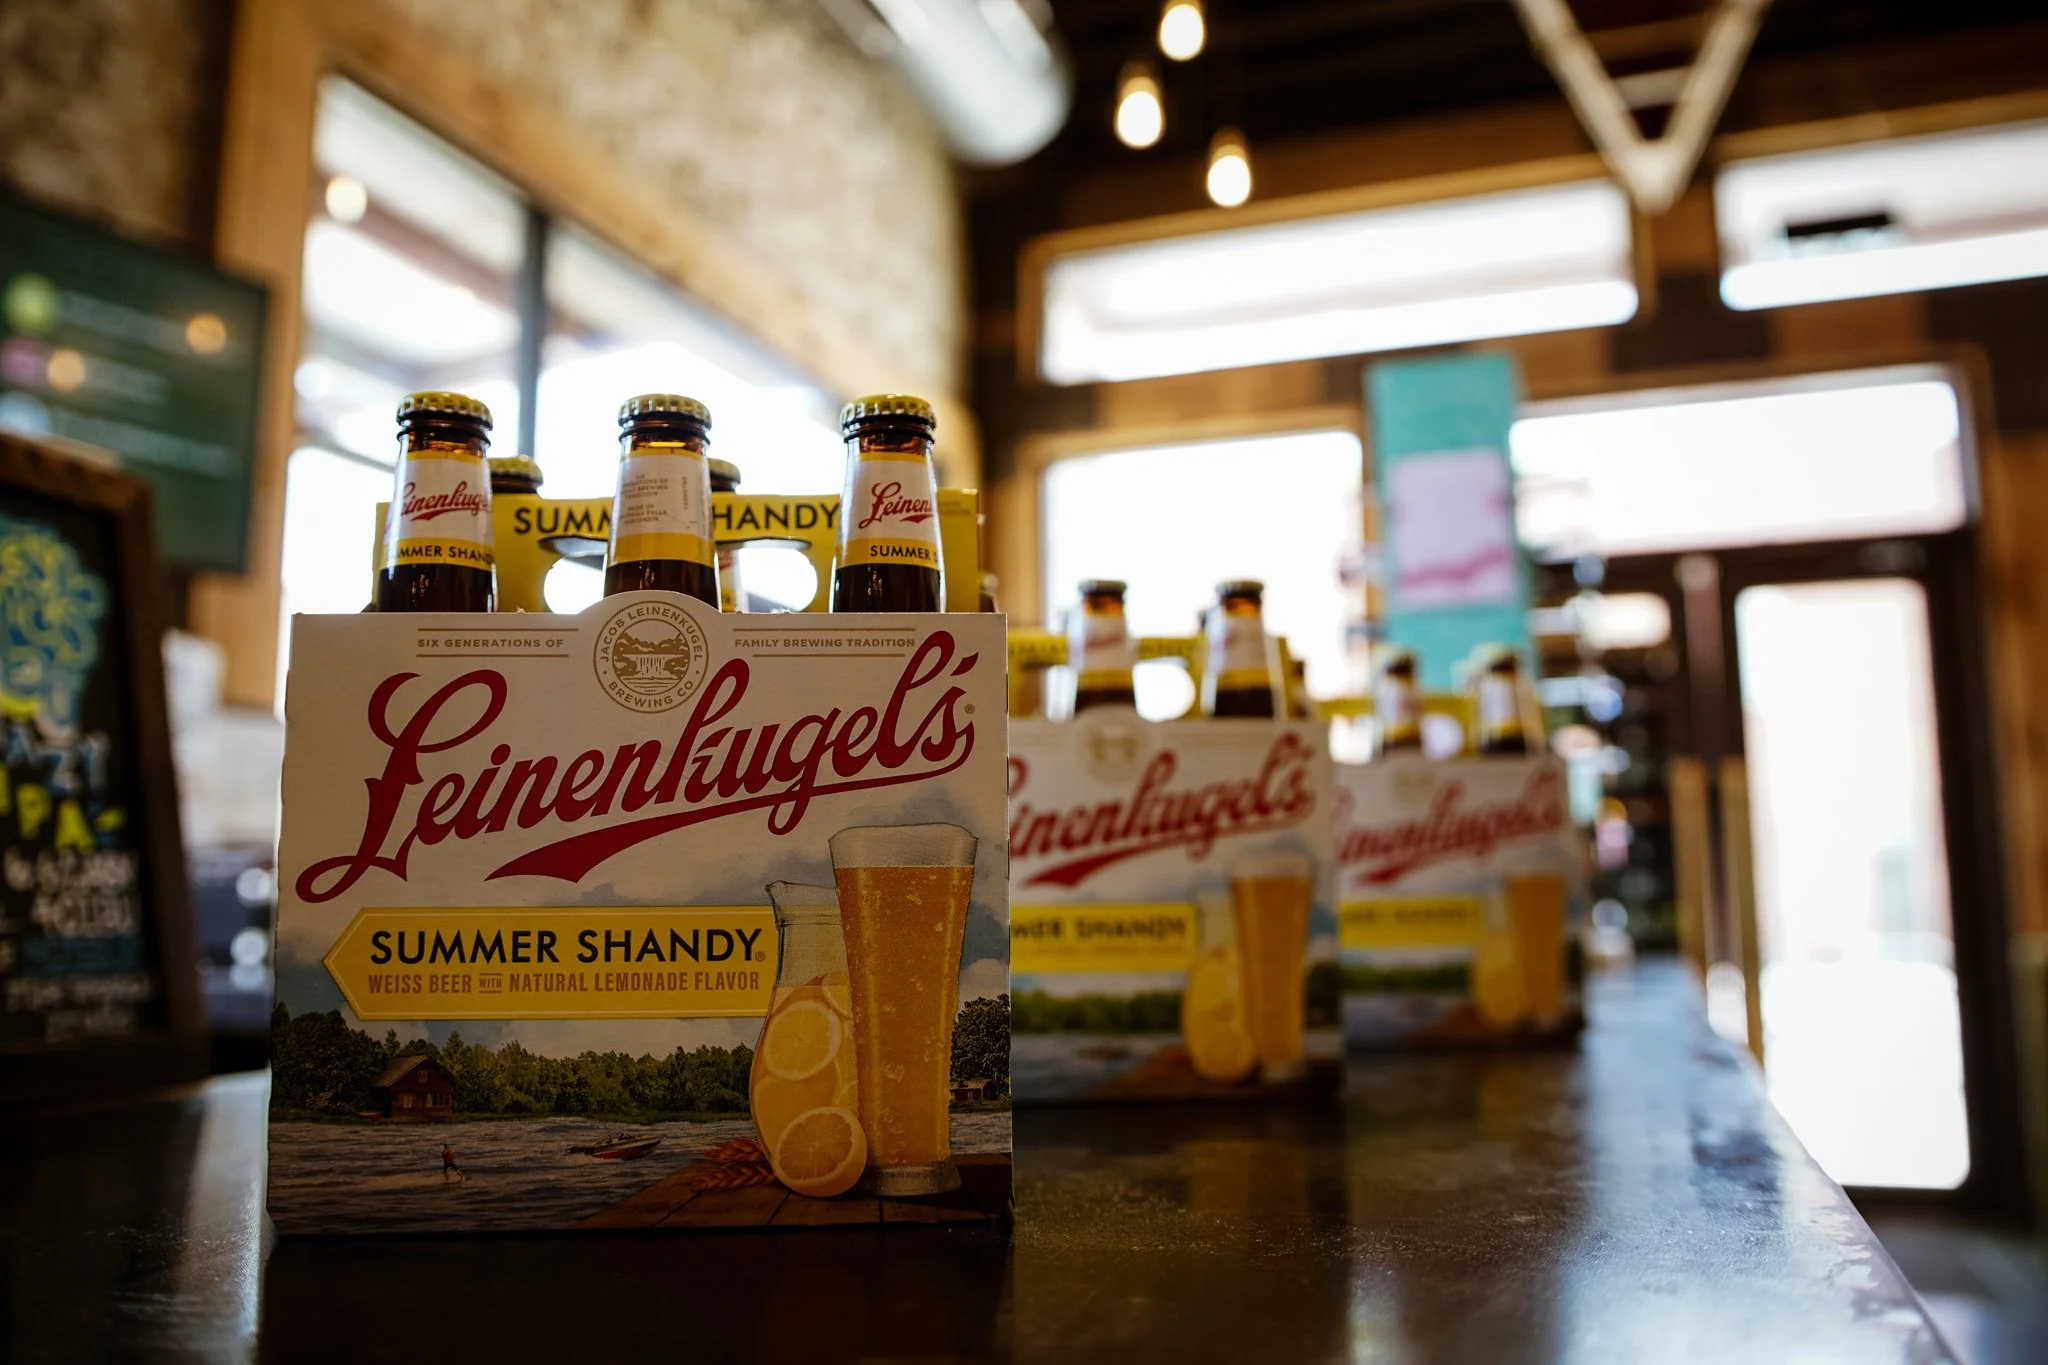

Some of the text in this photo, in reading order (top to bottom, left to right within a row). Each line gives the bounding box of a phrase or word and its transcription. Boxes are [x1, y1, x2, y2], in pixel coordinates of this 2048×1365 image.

[711, 503, 840, 531] HANDY
[858, 482, 933, 529] Leinen
[399, 545, 442, 558] MMER
[870, 545, 930, 560] SUMMER
[417, 639, 564, 648] SIX GENERATIONS OF
[600, 606, 703, 662] JACOB LEINENKUGEL
[734, 638, 916, 648] FAMILY BREWING TRADITION
[608, 681, 673, 708] BREWING
[295, 631, 979, 903] Leinenkugel's
[370, 929, 560, 965] SUMMER
[368, 971, 759, 994] WEISS BEER WITH NATURAL LEMONADE FLAVOR
